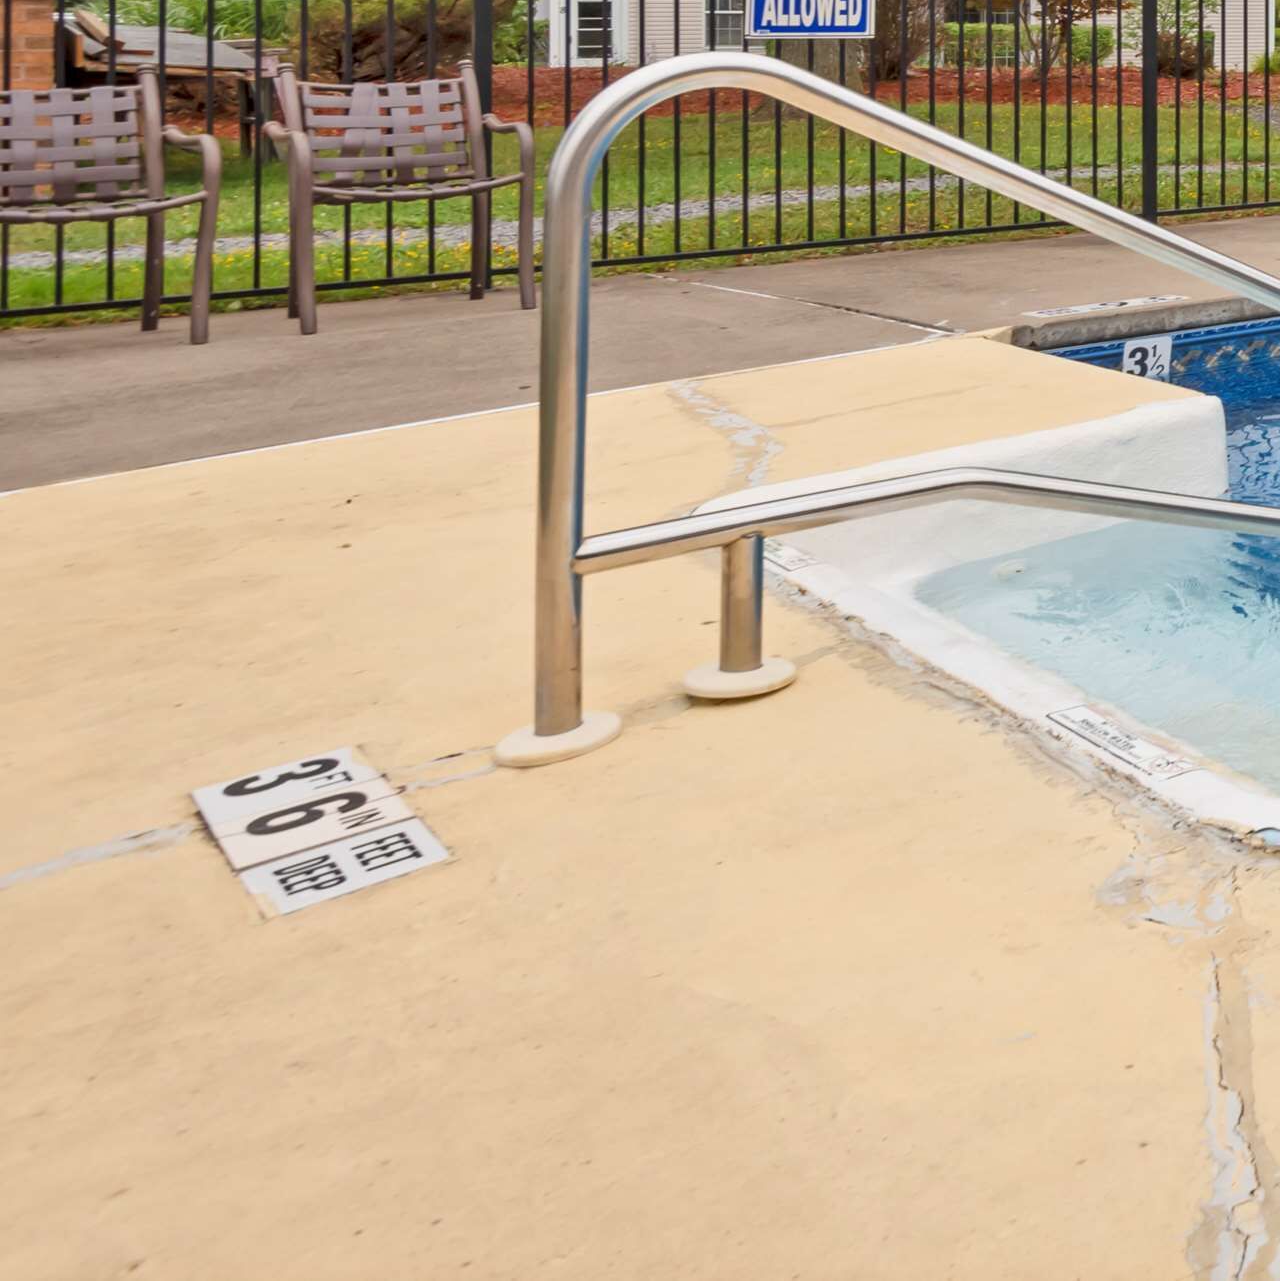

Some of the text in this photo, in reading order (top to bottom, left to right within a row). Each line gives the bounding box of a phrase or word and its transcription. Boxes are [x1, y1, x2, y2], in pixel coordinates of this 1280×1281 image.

[222, 758, 386, 836] 3 FT 6 IN
[350, 831, 424, 873] FEET
[272, 854, 347, 897] DEEP
